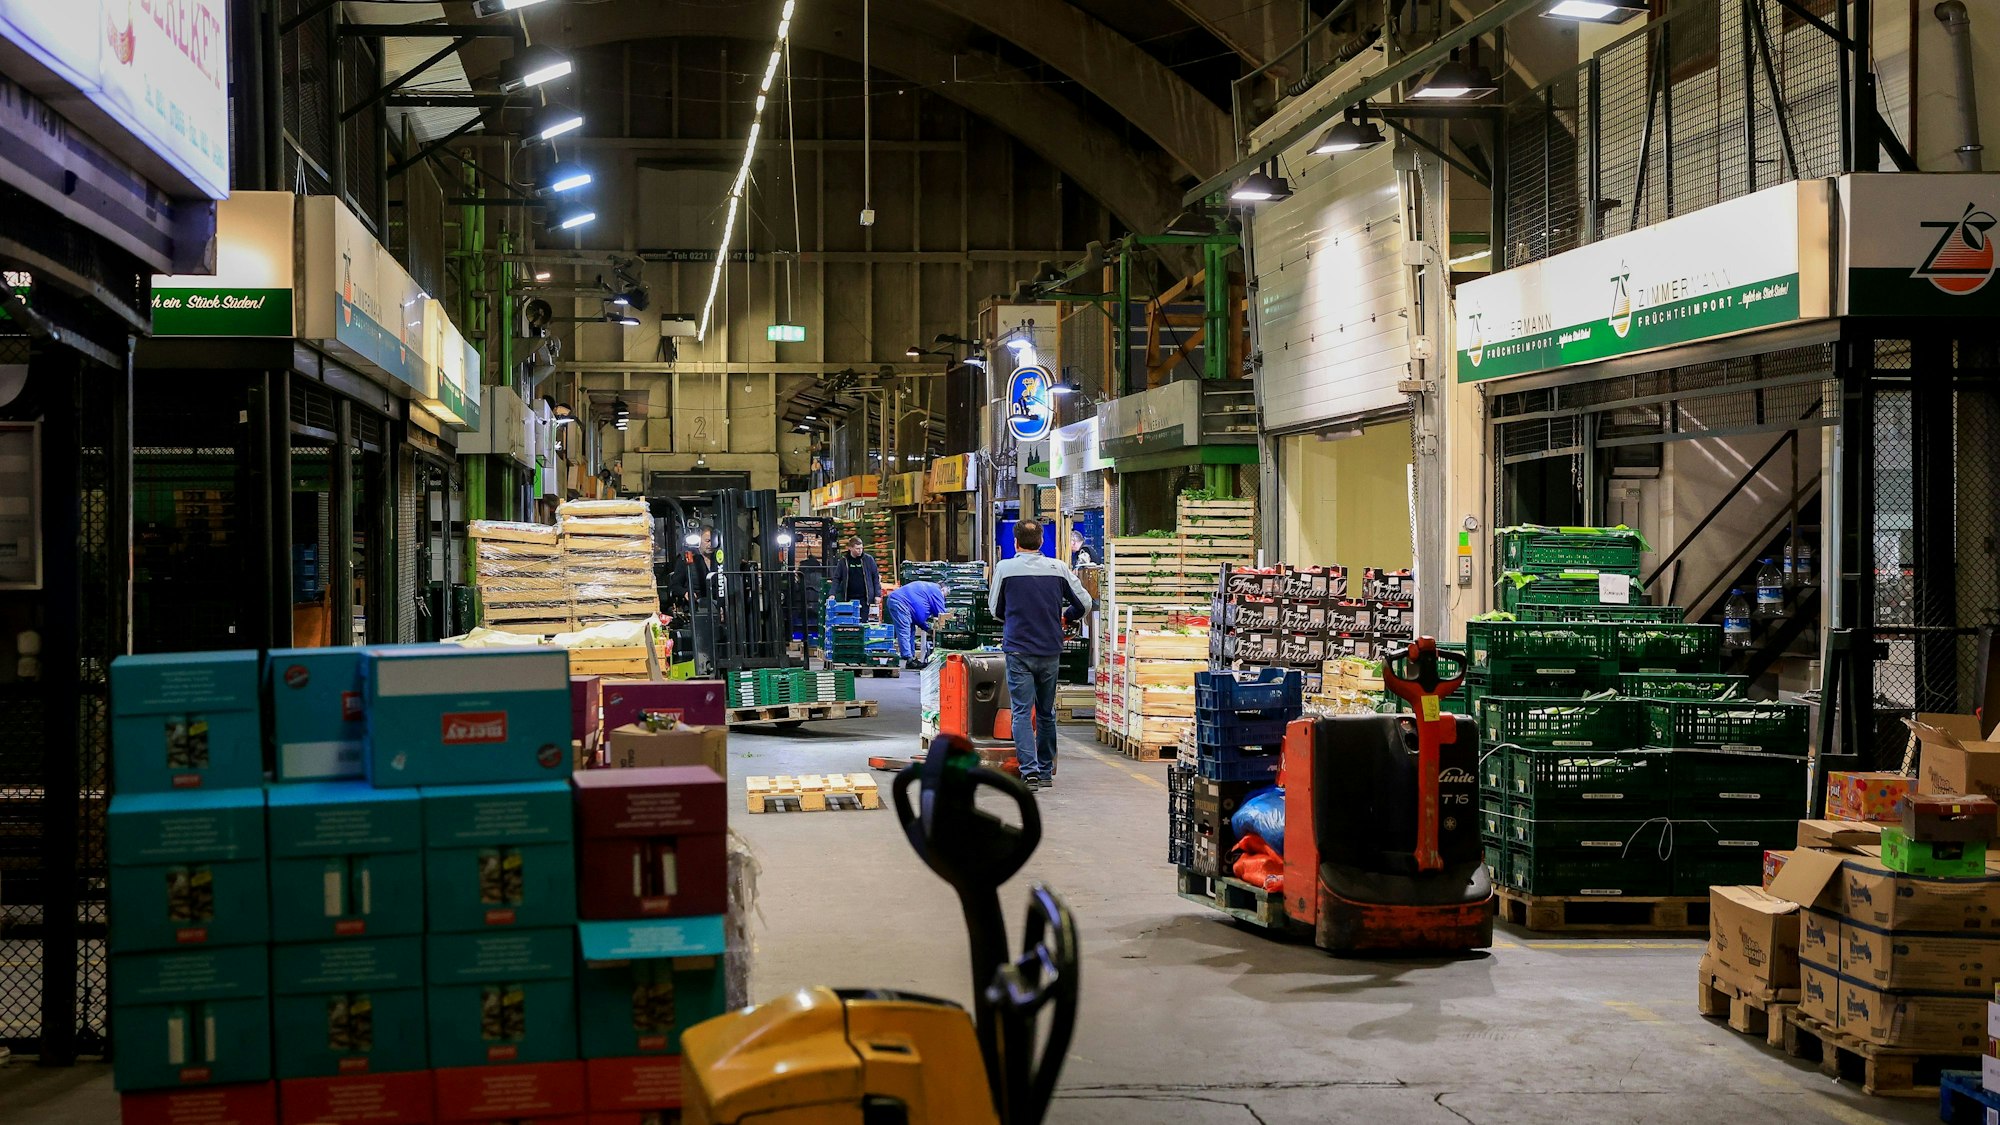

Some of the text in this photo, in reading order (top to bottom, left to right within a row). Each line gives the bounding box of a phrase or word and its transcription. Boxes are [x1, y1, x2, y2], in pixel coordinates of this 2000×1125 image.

[163, 297, 181, 308] ein
[186, 294, 221, 309] Stück
[221, 295, 266, 309] Süden!
[1638, 296, 1733, 328] FRÜCHTEIMPORT
[1487, 337, 1553, 359] FRÜCHTEIMPORT
[693, 416, 707, 439] 2
[717, 564, 725, 598] CLARK
[1438, 767, 1475, 783] Linde
[1441, 794, 1469, 804] T 16
